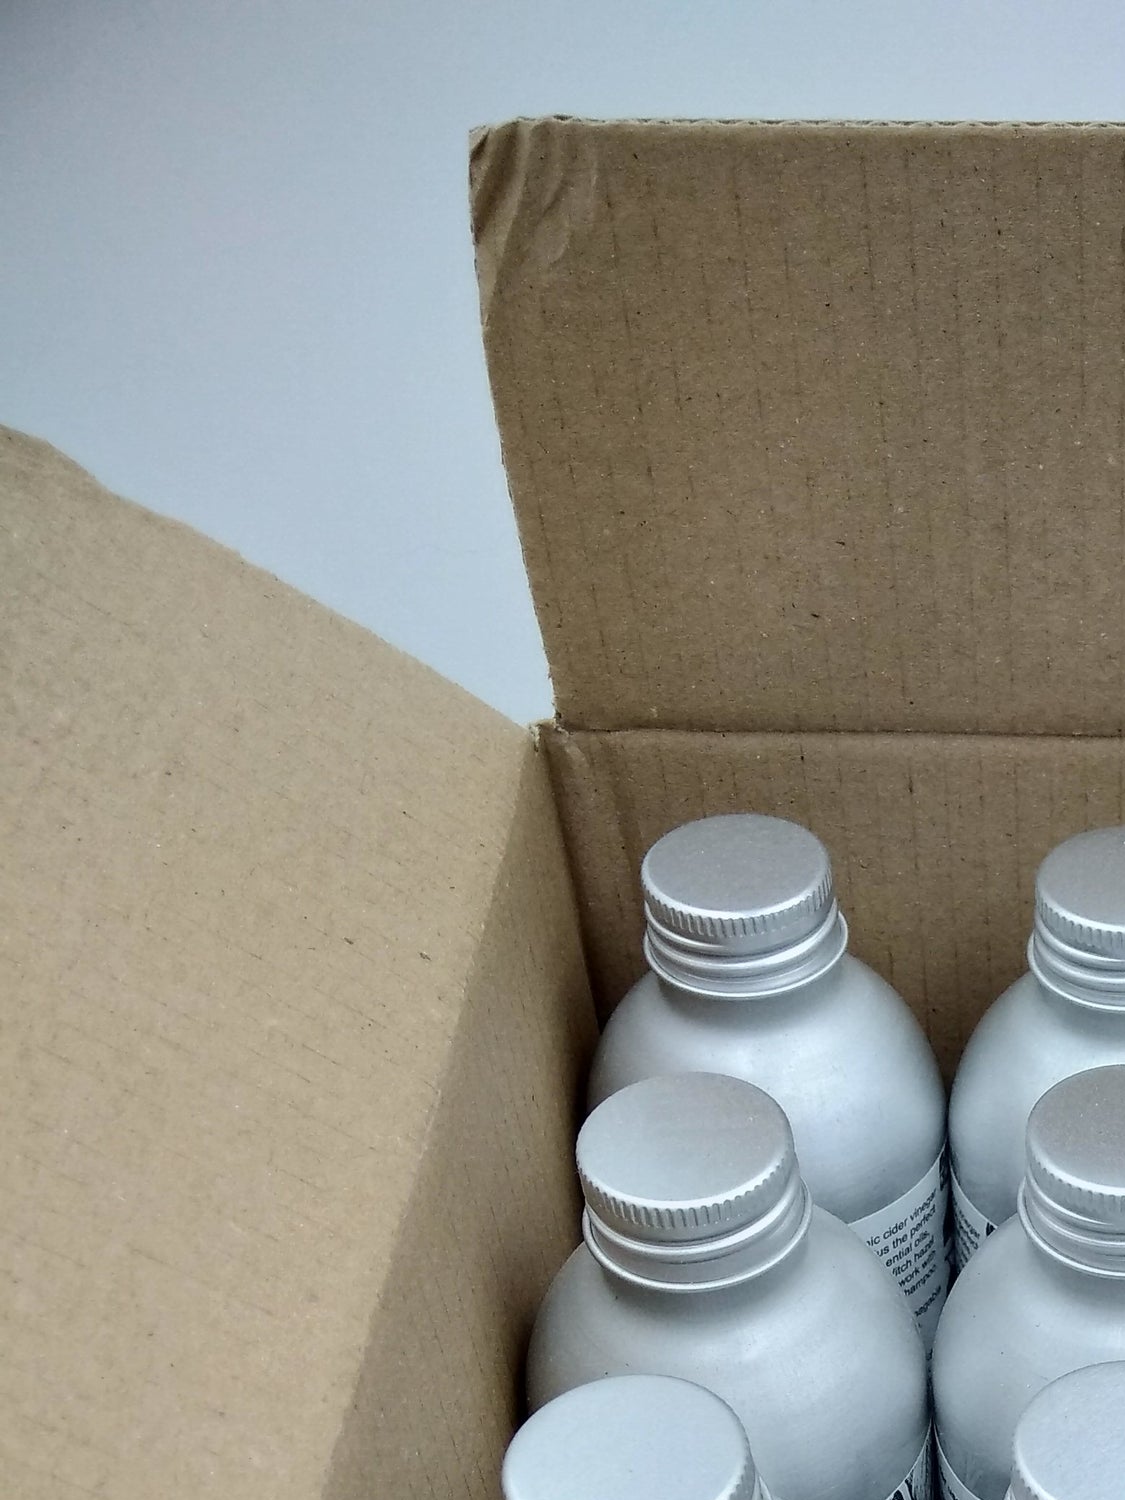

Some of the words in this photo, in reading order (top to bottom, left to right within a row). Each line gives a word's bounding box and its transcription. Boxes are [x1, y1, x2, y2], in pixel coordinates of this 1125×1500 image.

[883, 1218, 908, 1240] cider
[910, 1188, 936, 1221] vinegar
[892, 1233, 908, 1249] the
[910, 1204, 936, 1239] perfect
[886, 1243, 912, 1267] ential
